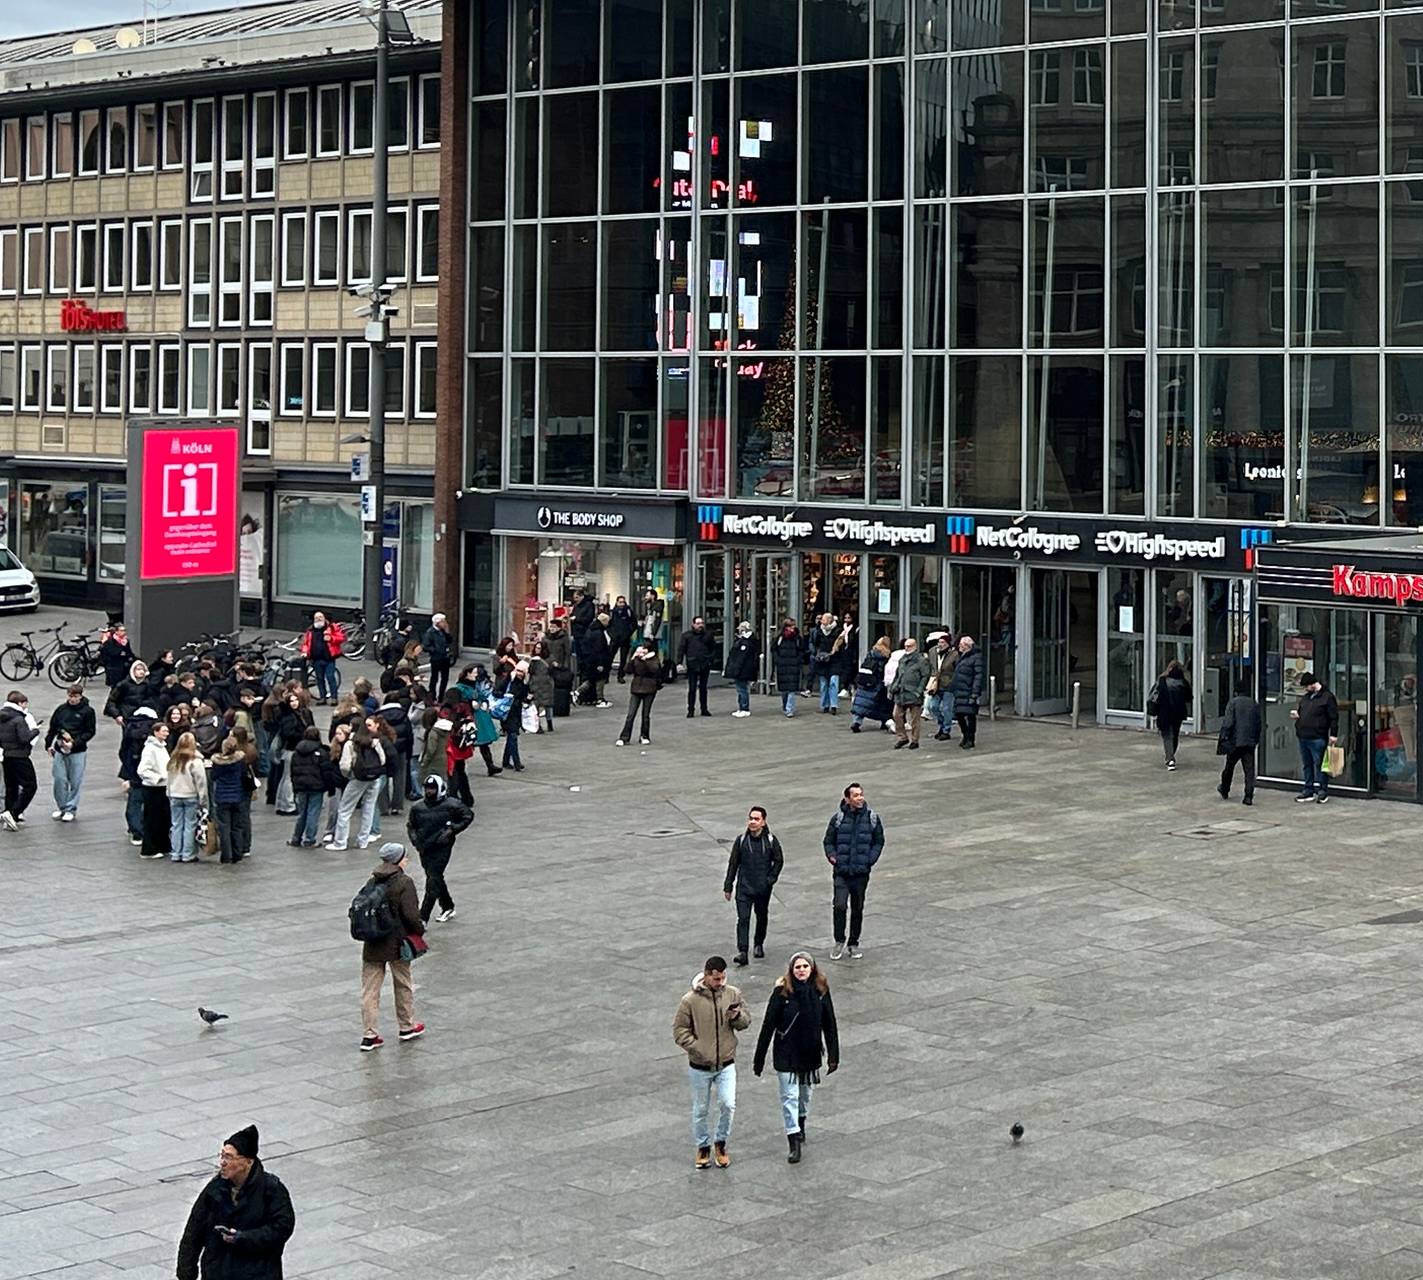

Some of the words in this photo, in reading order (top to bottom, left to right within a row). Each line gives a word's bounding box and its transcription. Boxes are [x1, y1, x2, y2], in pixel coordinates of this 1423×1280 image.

[182, 442, 213, 454] KÖLN
[553, 512, 571, 525] THE
[572, 513, 597, 526] BODY
[598, 514, 624, 527] SHOP
[723, 514, 813, 541] NetCologne
[848, 519, 936, 546] Highspeed
[976, 526, 1081, 554] NetCologne
[1125, 532, 1226, 560] Highspeed
